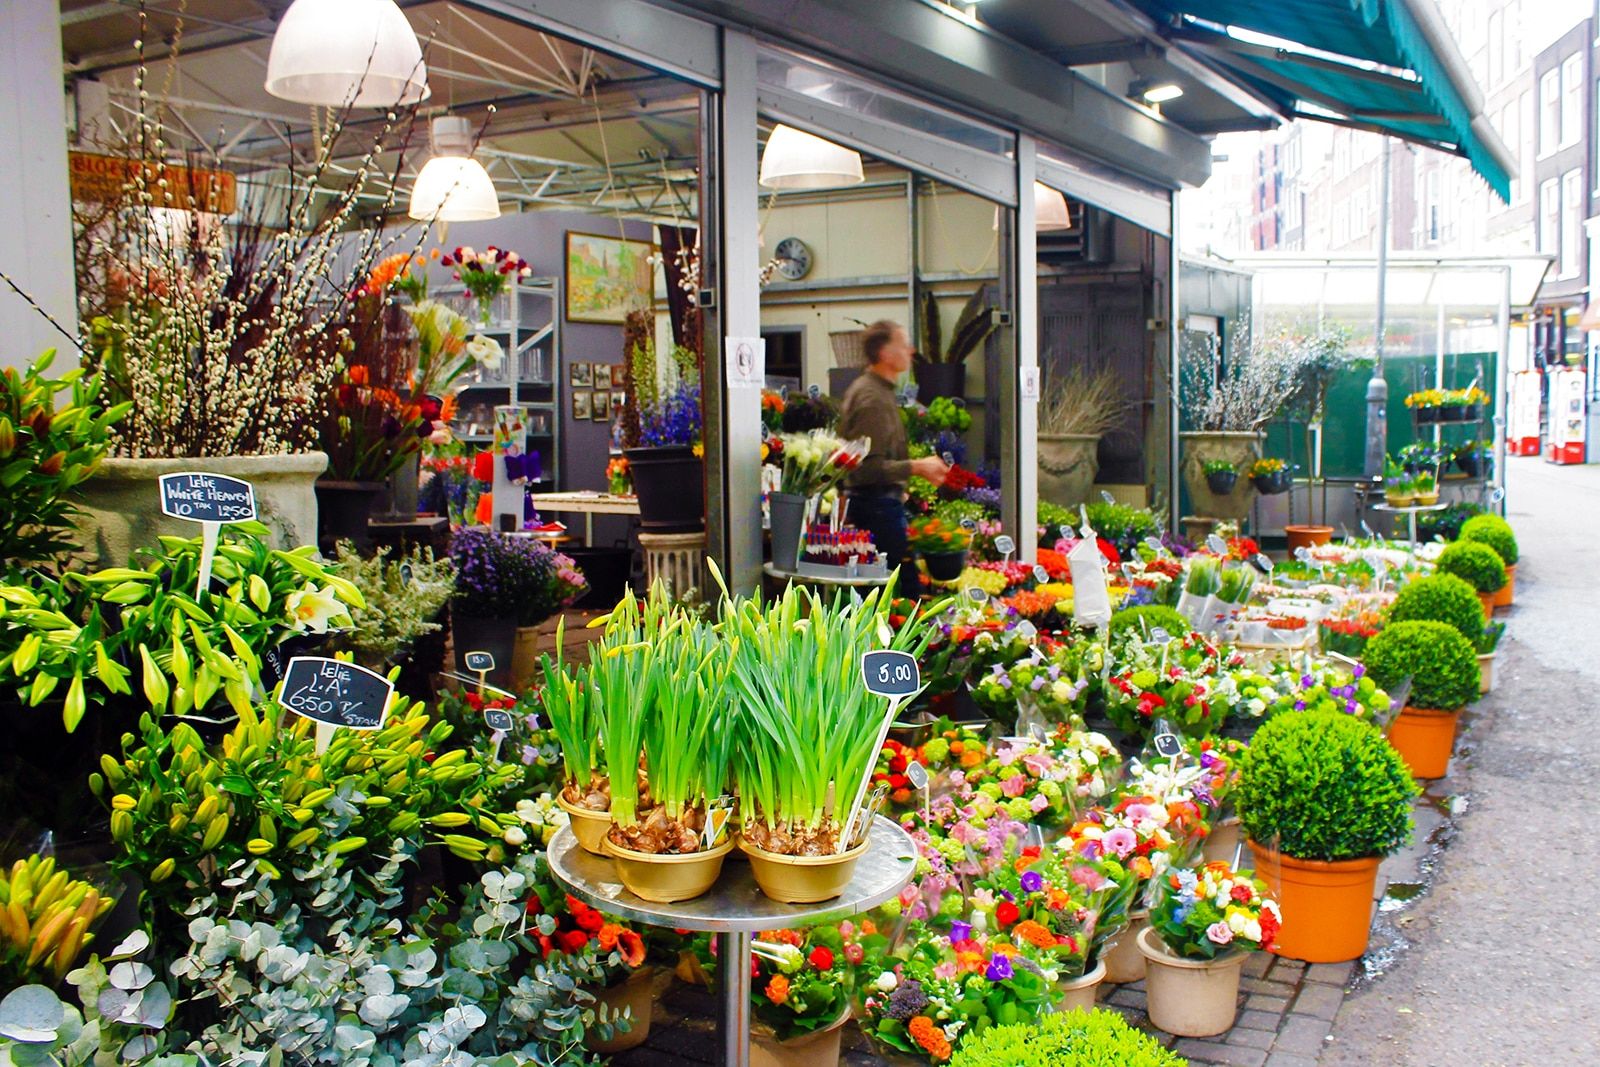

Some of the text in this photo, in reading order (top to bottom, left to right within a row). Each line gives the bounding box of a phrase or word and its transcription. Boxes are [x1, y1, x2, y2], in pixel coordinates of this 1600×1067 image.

[174, 502, 193, 515] 10
[193, 502, 212, 510] TAK
[878, 663, 911, 684] 5,00
[309, 673, 348, 697] L.A.
[289, 686, 333, 713] 6.50
